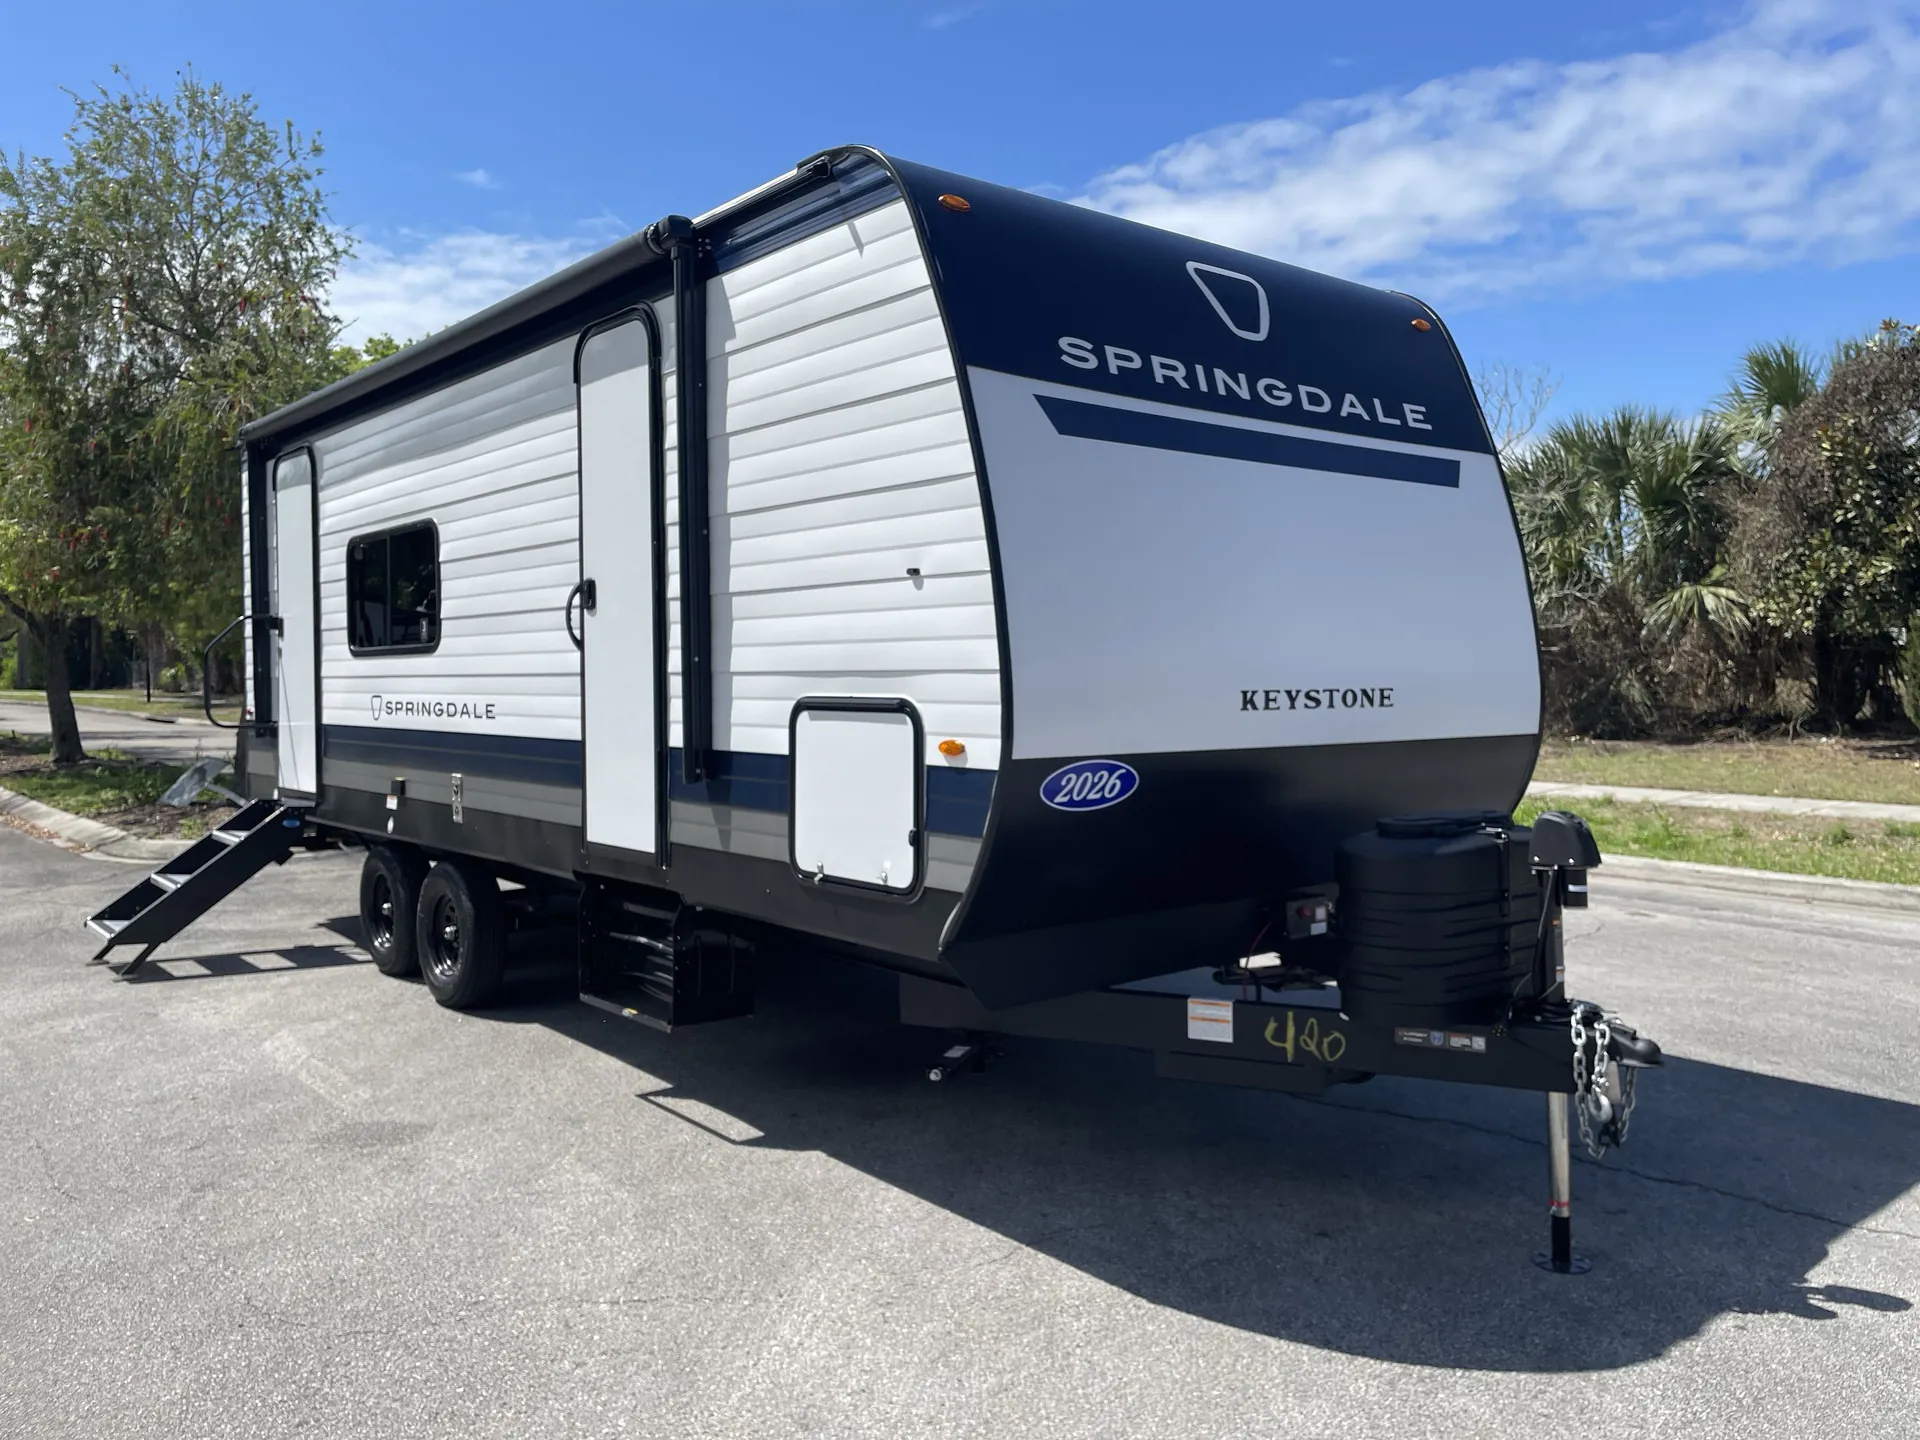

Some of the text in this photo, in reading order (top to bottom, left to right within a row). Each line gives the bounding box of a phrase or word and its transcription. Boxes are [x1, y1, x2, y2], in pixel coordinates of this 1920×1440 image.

[1057, 336, 1433, 431] SPRINGDALE
[384, 700, 497, 720] SPRINGDALE
[1240, 687, 1395, 711] KEYSTONE
[1053, 768, 1127, 803] 2026
